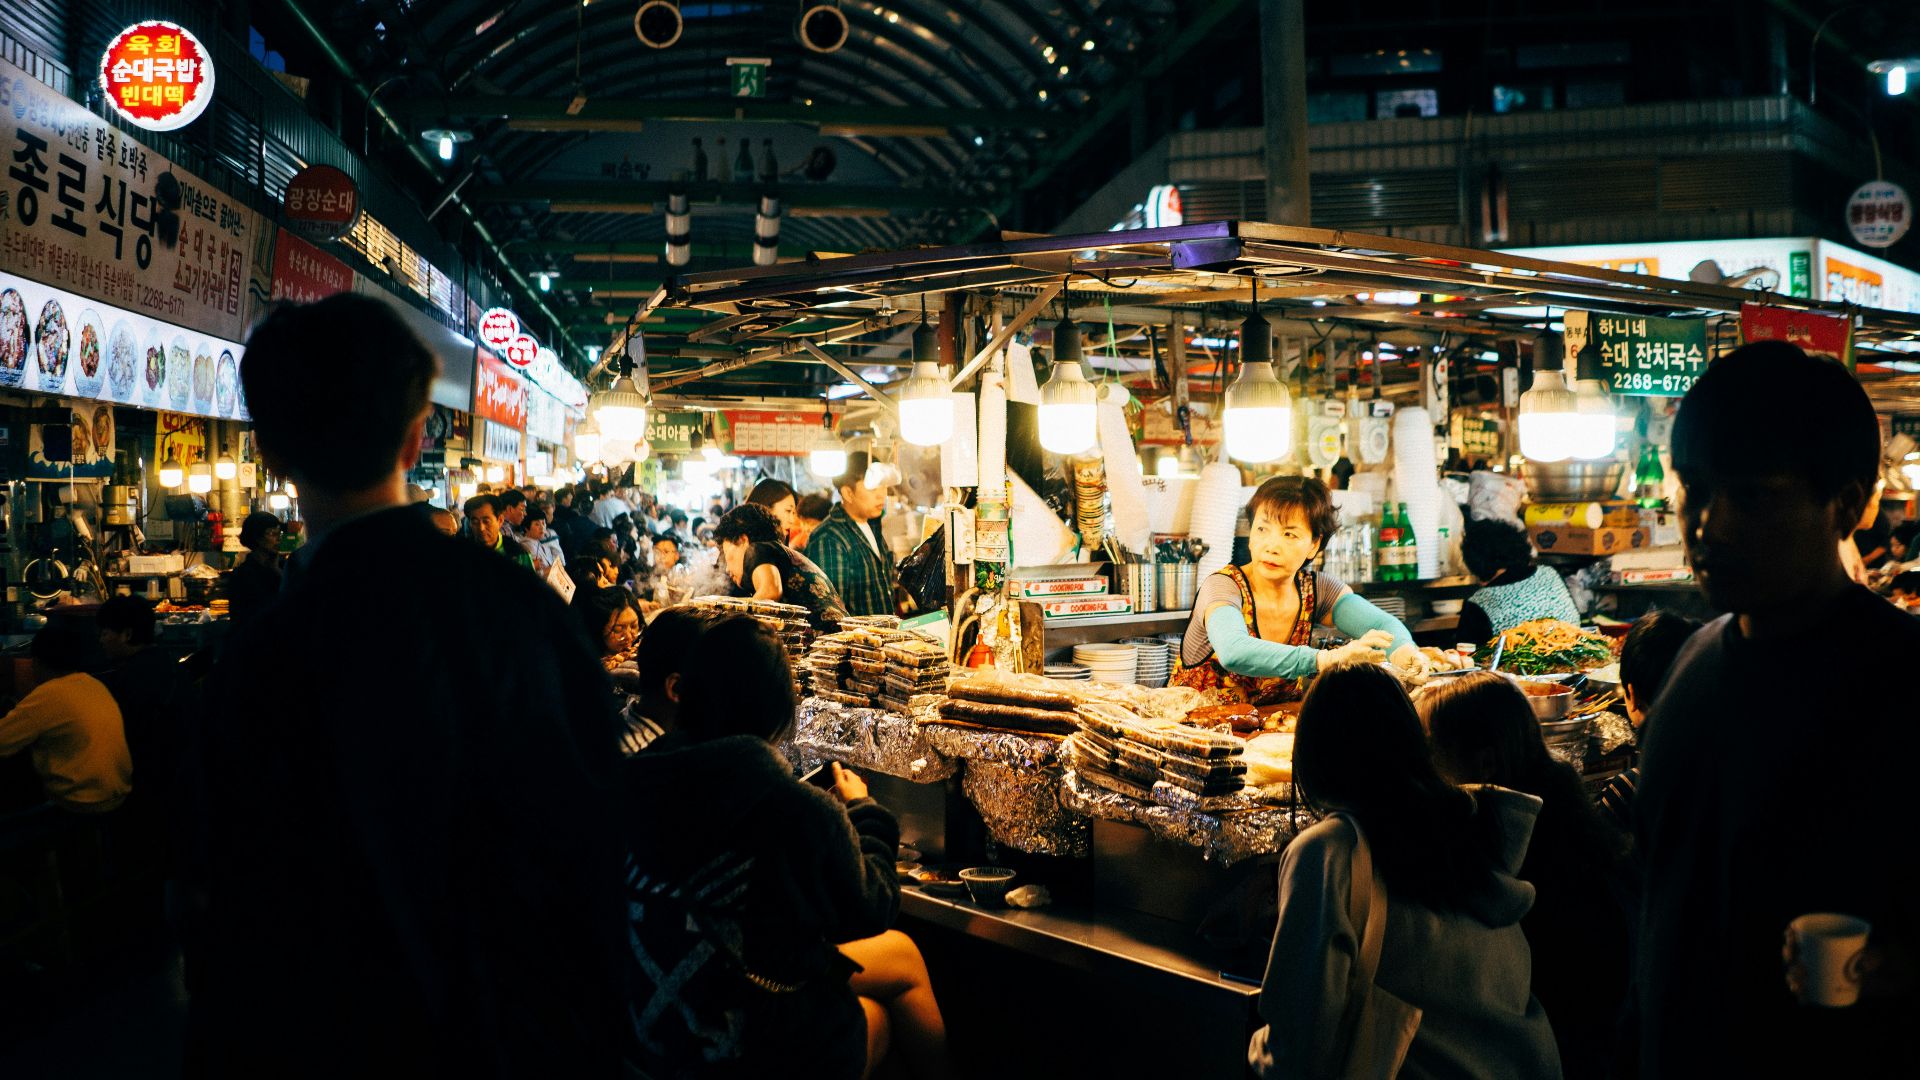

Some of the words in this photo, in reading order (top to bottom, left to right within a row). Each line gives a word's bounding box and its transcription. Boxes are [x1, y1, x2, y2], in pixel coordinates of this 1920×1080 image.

[126, 35, 181, 54] 육회
[111, 58, 197, 84] 순대국밥
[121, 85, 184, 107] 빈대떡
[95, 127, 117, 166] 팥죽
[118, 140, 149, 184] 호박죽
[9, 129, 158, 270] 종로식당
[288, 187, 354, 214] 광장순대
[173, 260, 226, 311] 소고기장국밥
[1599, 318, 1647, 338] 하니네
[1600, 341, 1630, 369] 순대
[1635, 342, 1704, 371] 잔치국수
[1049, 584, 1075, 592] COOKING
[1071, 604, 1097, 612] COOKING
